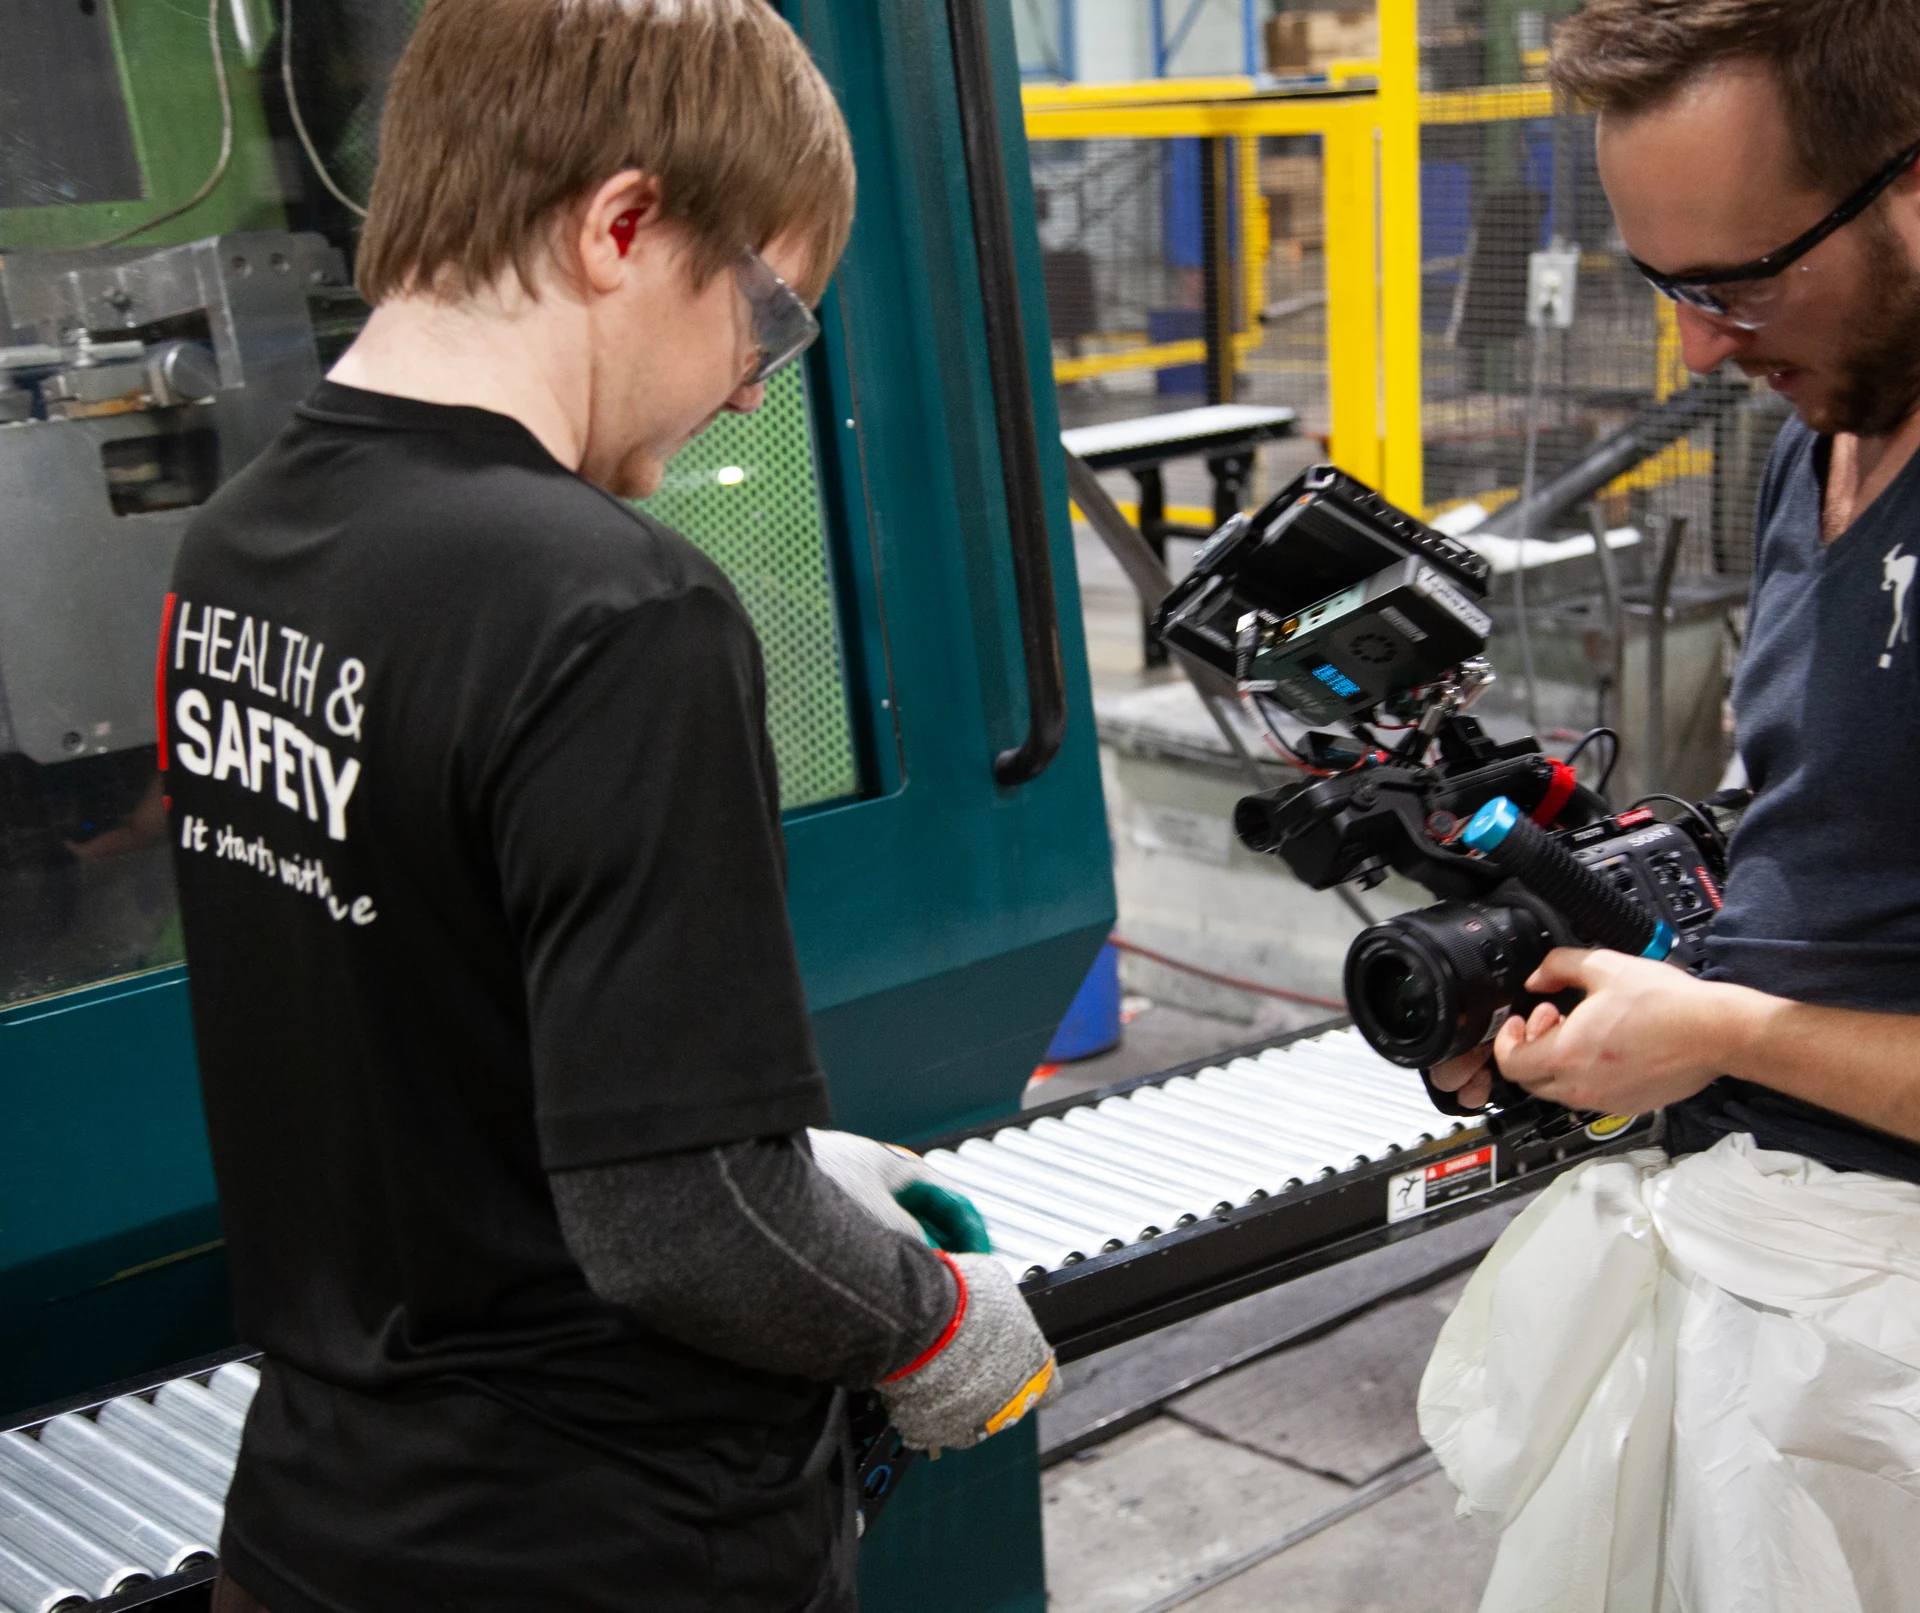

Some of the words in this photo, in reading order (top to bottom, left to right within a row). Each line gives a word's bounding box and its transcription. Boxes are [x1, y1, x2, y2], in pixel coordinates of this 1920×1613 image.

[175, 601, 324, 718] HEALTH
[325, 658, 366, 743] &
[175, 689, 361, 842] SAFETY
[181, 815, 209, 852] It
[216, 824, 277, 877] starts
[1627, 826, 1675, 848] SONY
